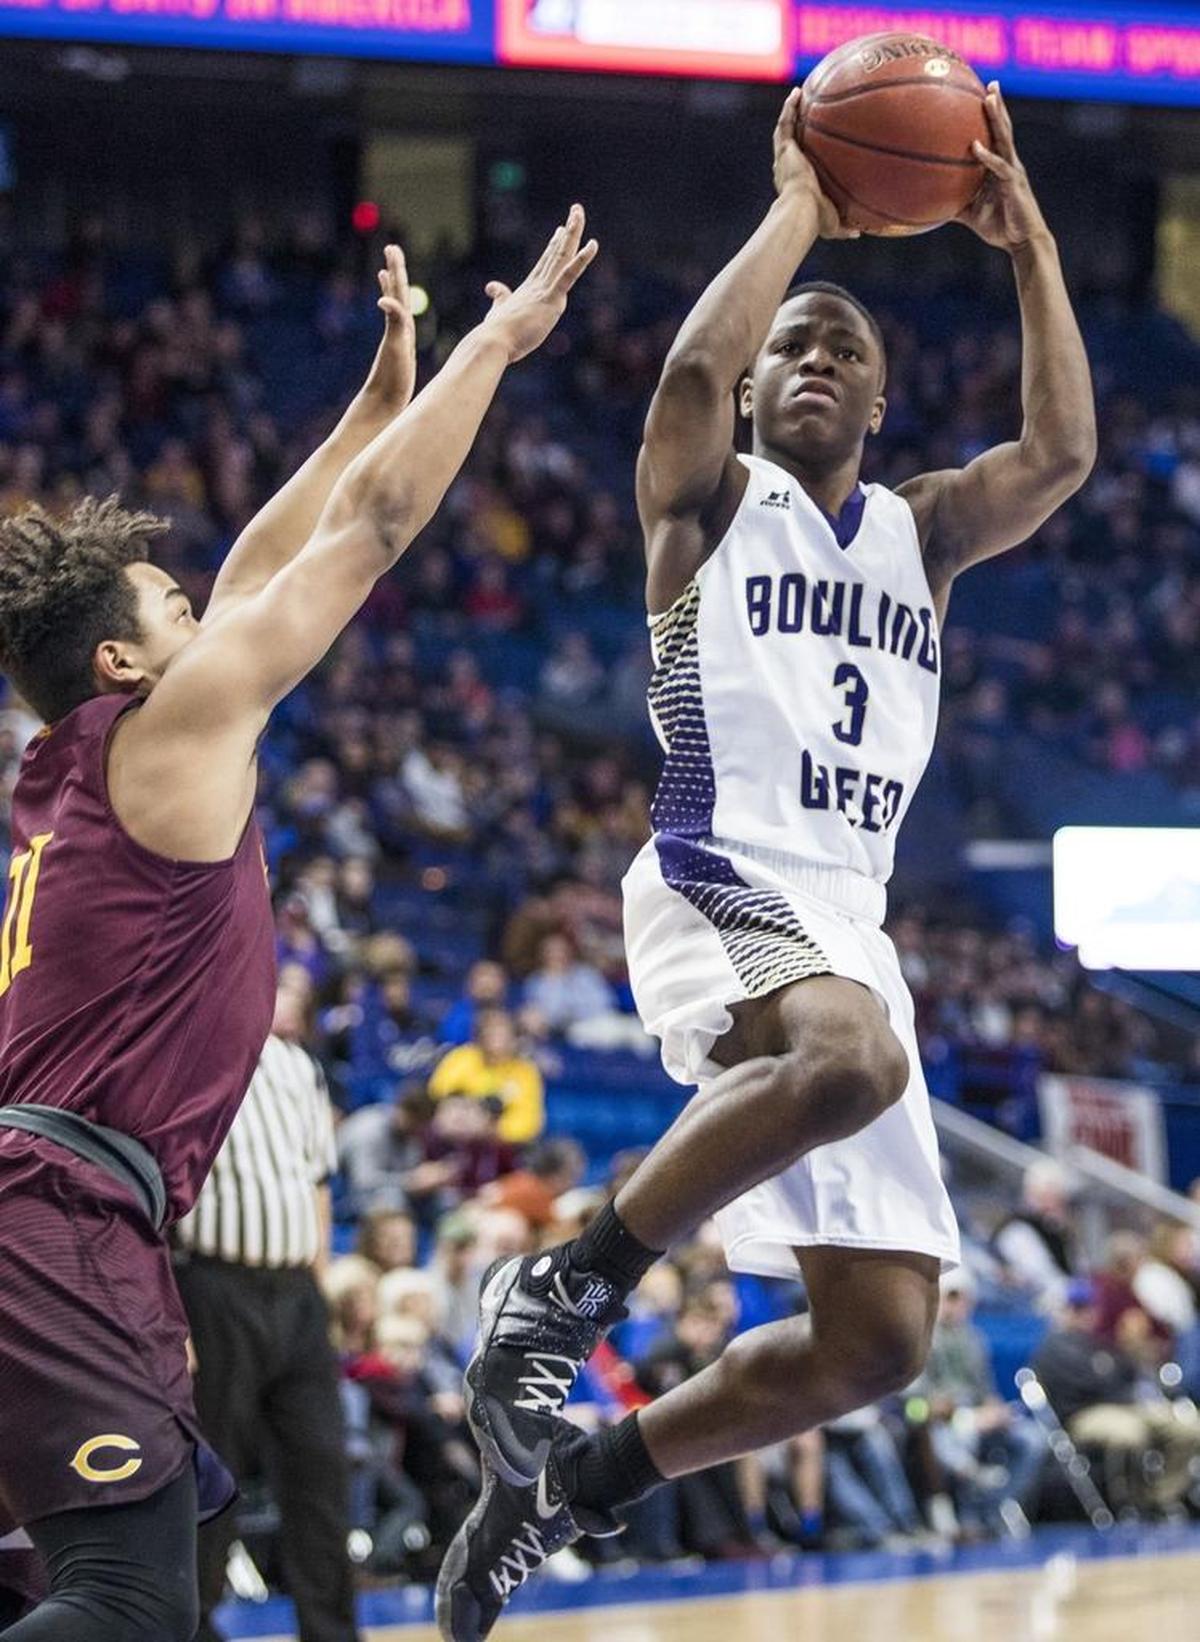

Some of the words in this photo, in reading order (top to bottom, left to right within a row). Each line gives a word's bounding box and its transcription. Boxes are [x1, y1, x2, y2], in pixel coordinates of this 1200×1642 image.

[746, 572, 938, 675] BOWLING
[832, 662, 869, 746] 3
[69, 1433, 143, 1482] C
